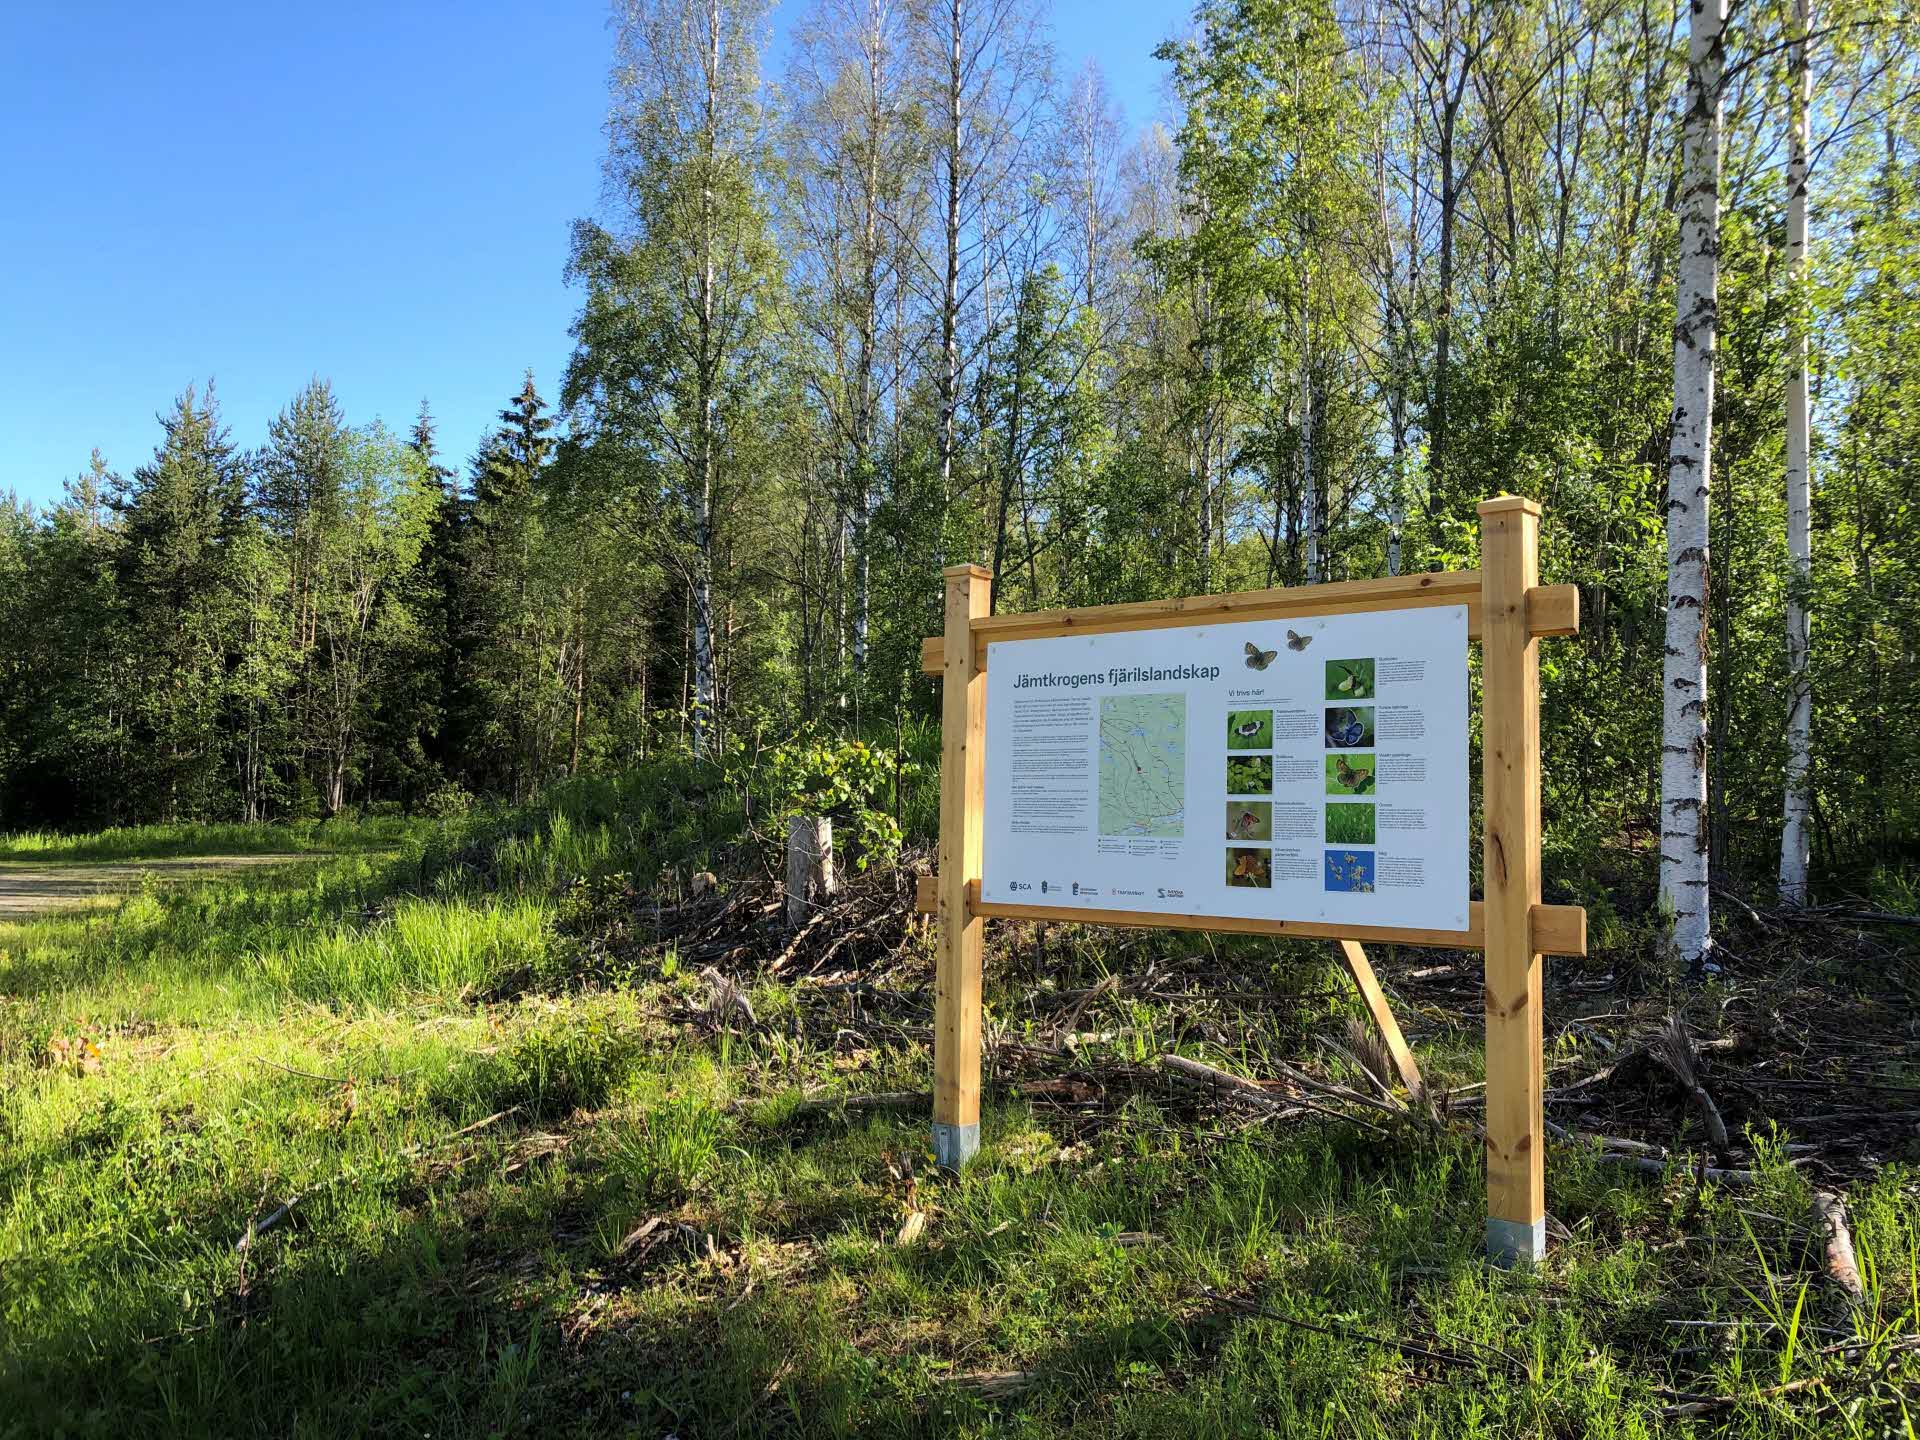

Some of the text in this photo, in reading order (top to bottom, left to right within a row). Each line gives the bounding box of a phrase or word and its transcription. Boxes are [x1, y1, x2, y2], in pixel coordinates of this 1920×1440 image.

[1014, 664, 1220, 688] Jämtkrogens fjärilslandskap
[1228, 689, 1235, 697] Vi
[1236, 689, 1251, 697] trivs
